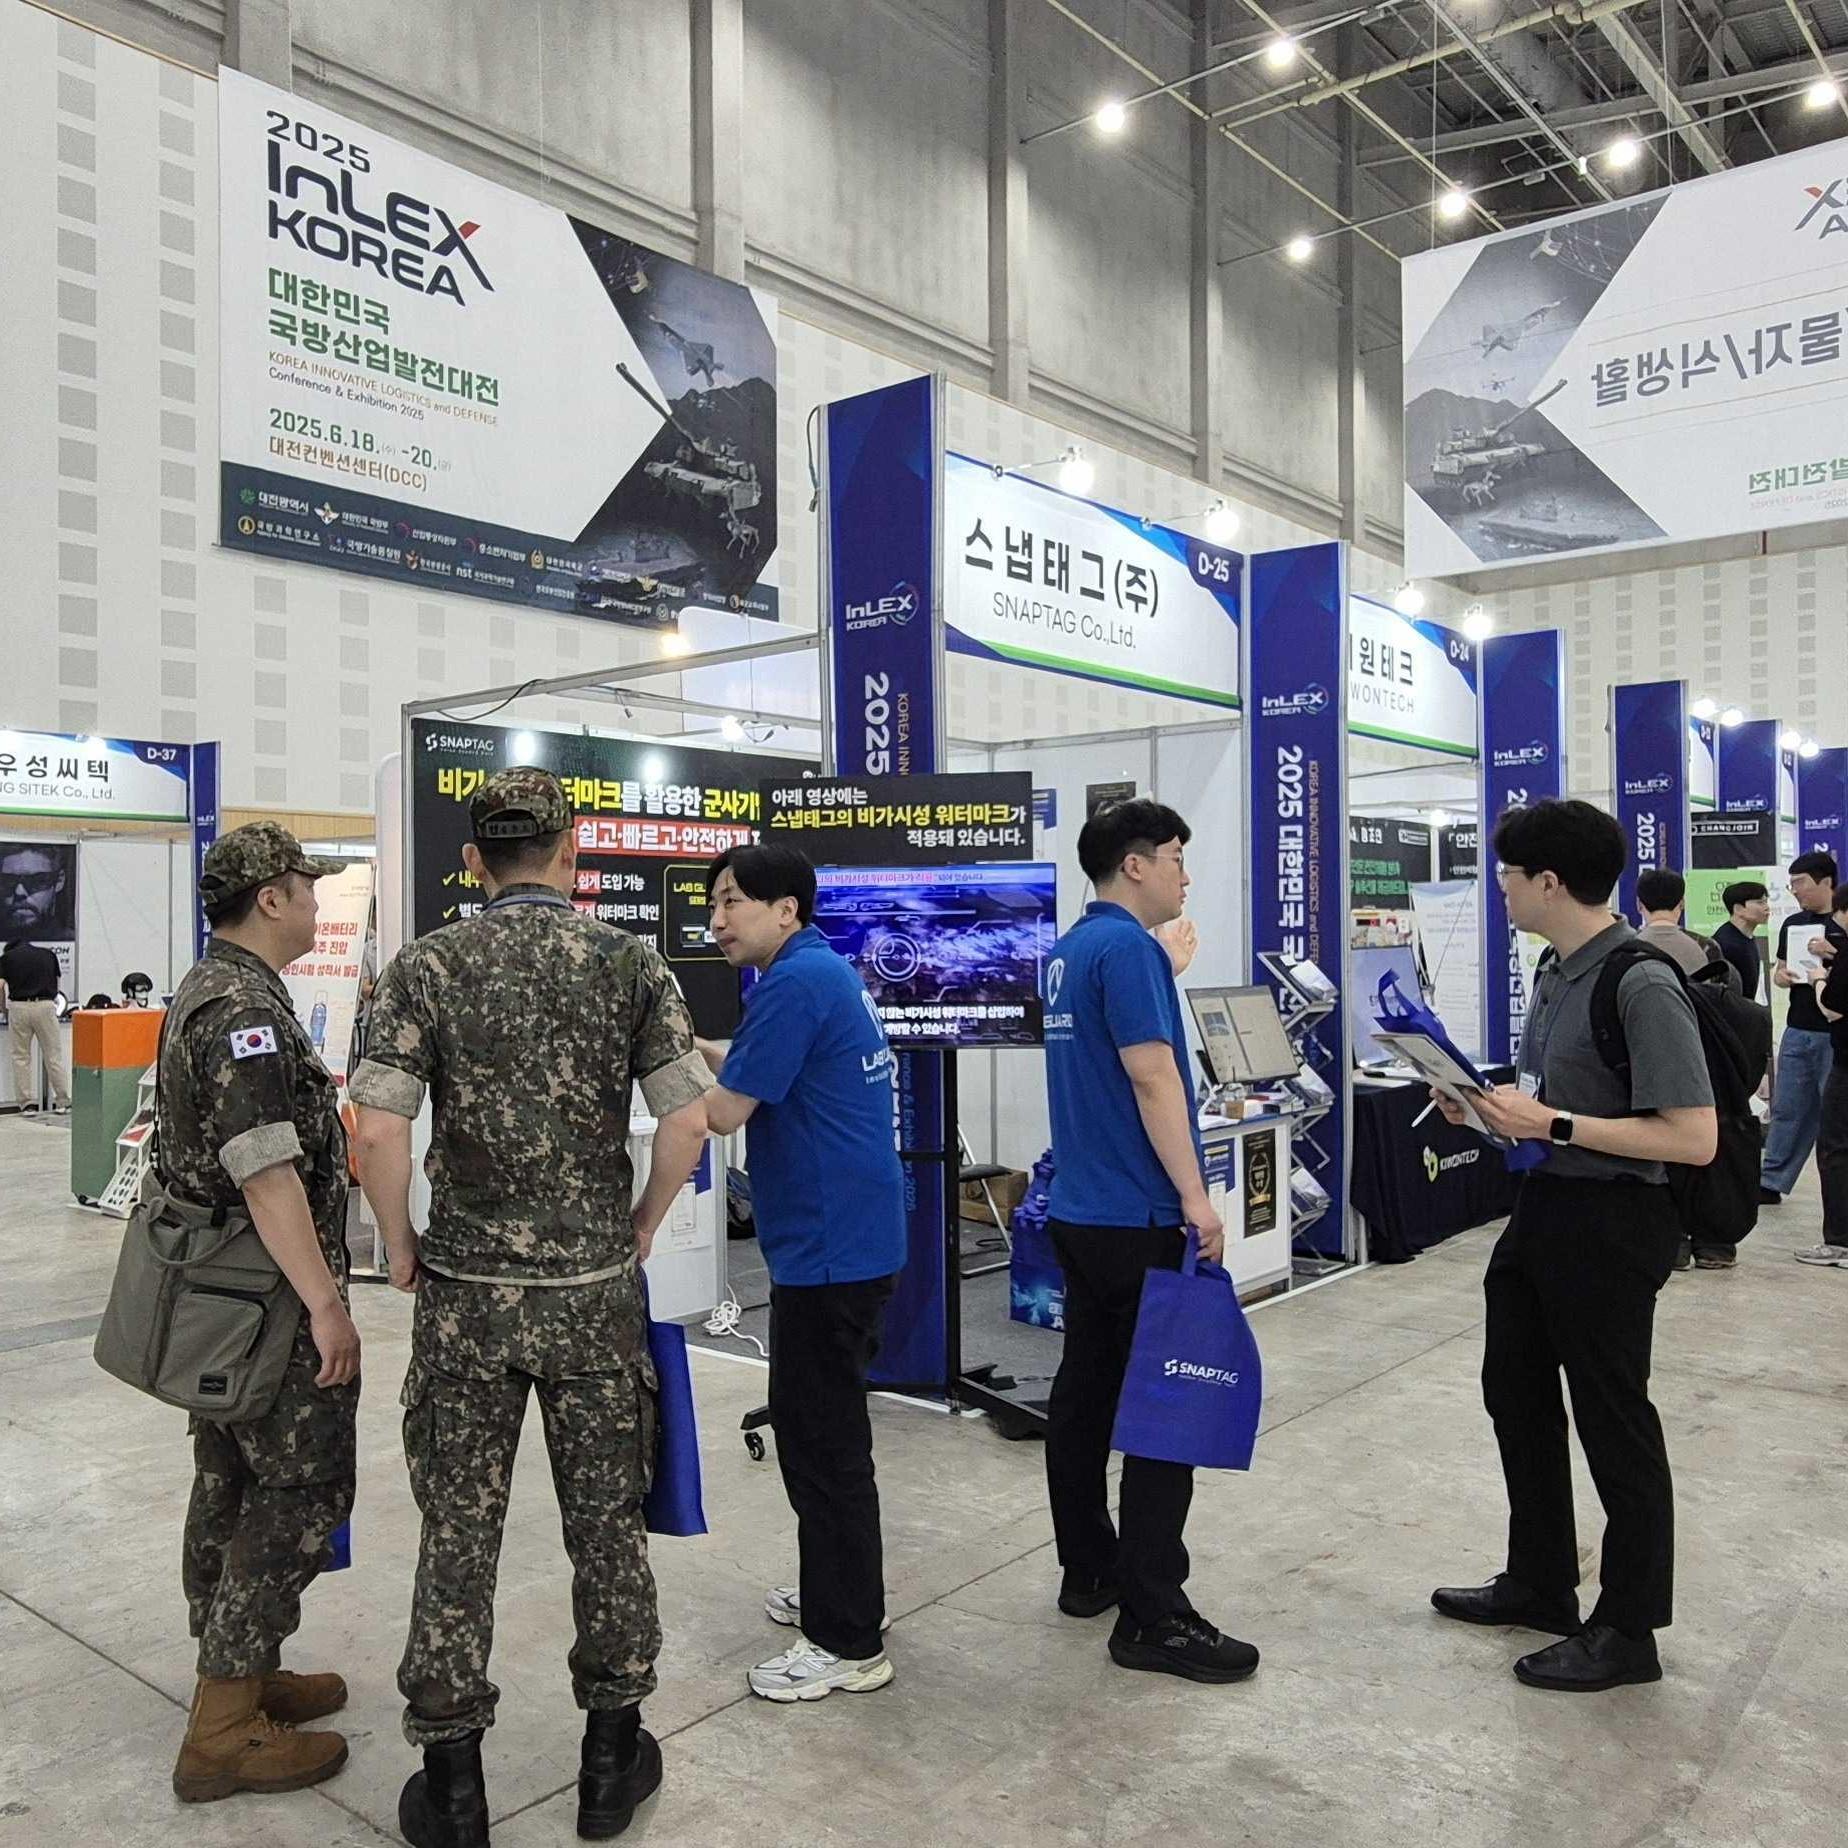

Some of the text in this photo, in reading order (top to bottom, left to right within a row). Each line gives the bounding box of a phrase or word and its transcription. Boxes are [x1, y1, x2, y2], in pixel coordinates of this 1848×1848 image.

[266, 110, 371, 173] 2025
[268, 138, 496, 293] InLEX
[269, 200, 467, 307] KOREA
[268, 267, 391, 336] 대한민국
[268, 308, 499, 407] 국방산업발전대전
[268, 351, 498, 426] KOREA INNOVATIVE LOGISTICS and DEFENSE
[268, 366, 425, 421] Conference & Exhibition 2025
[269, 435, 428, 492] 대전컨벤션센터(DCC)
[965, 518, 1159, 618] 스냅태그(주)
[1198, 551, 1230, 583] D-25
[992, 591, 1077, 634] SNAPTAG
[1350, 633, 1414, 687] 원테크
[439, 735, 495, 752] SNAPTAG
[864, 671, 890, 776] 2025
[897, 692, 910, 744] KOREA
[147, 747, 177, 761] D-37
[19, 783, 59, 797] SITEK
[63, 786, 89, 800] Co.,
[91, 787, 115, 801] Ltd.
[437, 767, 486, 802] 비가
[644, 783, 702, 817] 활용한
[771, 787, 868, 806] 아래 영상에는
[1277, 744, 1304, 819] 2025
[770, 804, 1026, 829] 스냅태그의 비가시성 워터마크가
[906, 828, 1026, 848] 적용돼 있습니다.
[1636, 812, 1656, 860] 2025
[601, 874, 623, 891] 도입
[624, 874, 646, 891] 가능
[1277, 825, 1305, 929] 대한민국
[597, 903, 639, 921] 워터마크
[639, 903, 660, 921] 확인
[1179, 1362, 1239, 1385] SNAPTAG
